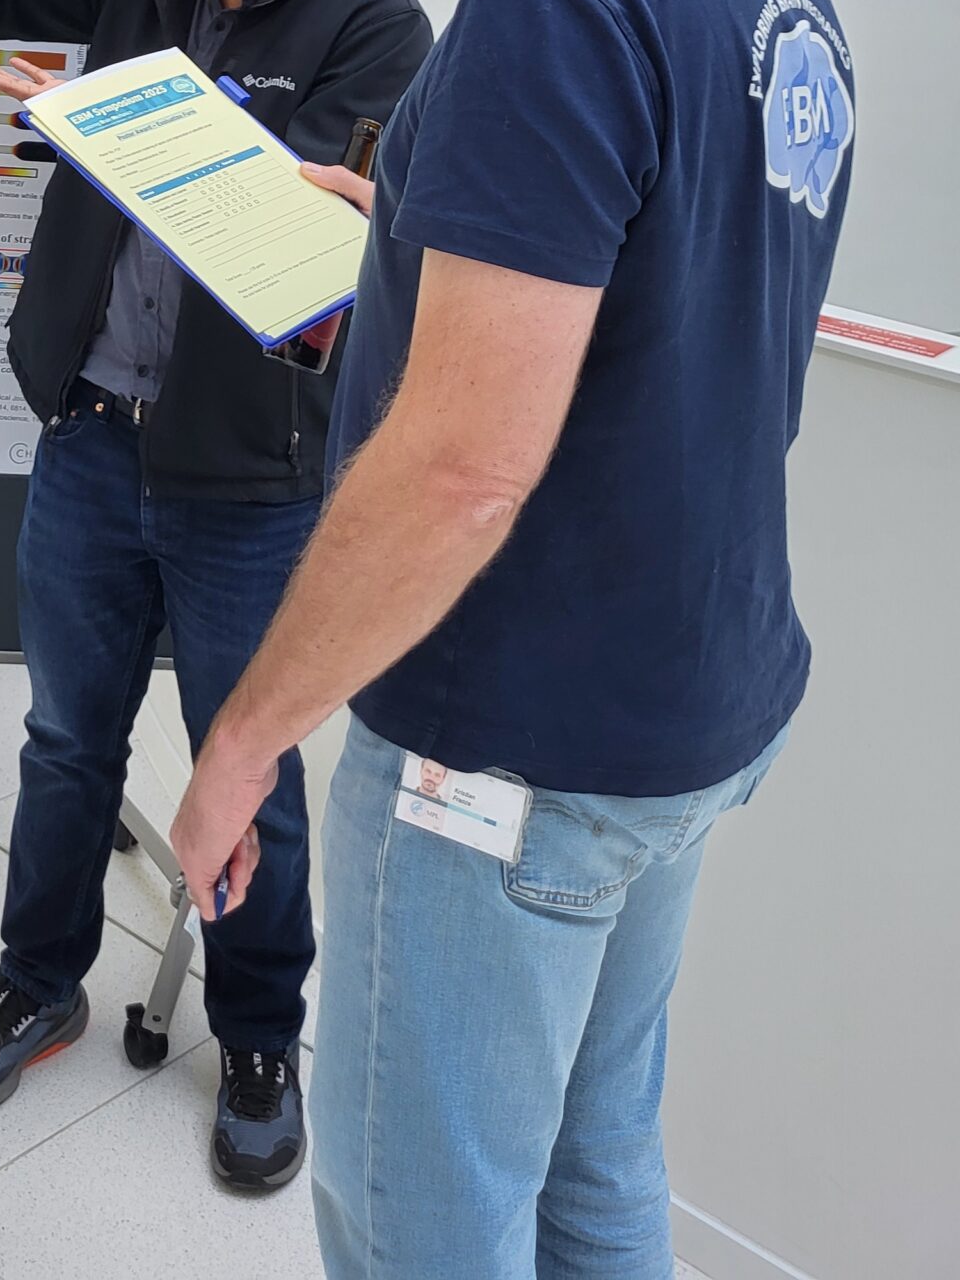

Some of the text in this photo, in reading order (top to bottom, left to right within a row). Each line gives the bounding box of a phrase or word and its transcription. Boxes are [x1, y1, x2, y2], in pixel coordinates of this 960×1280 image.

[69, 109, 95, 125] EBM
[91, 92, 145, 117] Symposium
[140, 85, 168, 99] 2025
[0, 234, 13, 244] of
[13, 235, 30, 245] str
